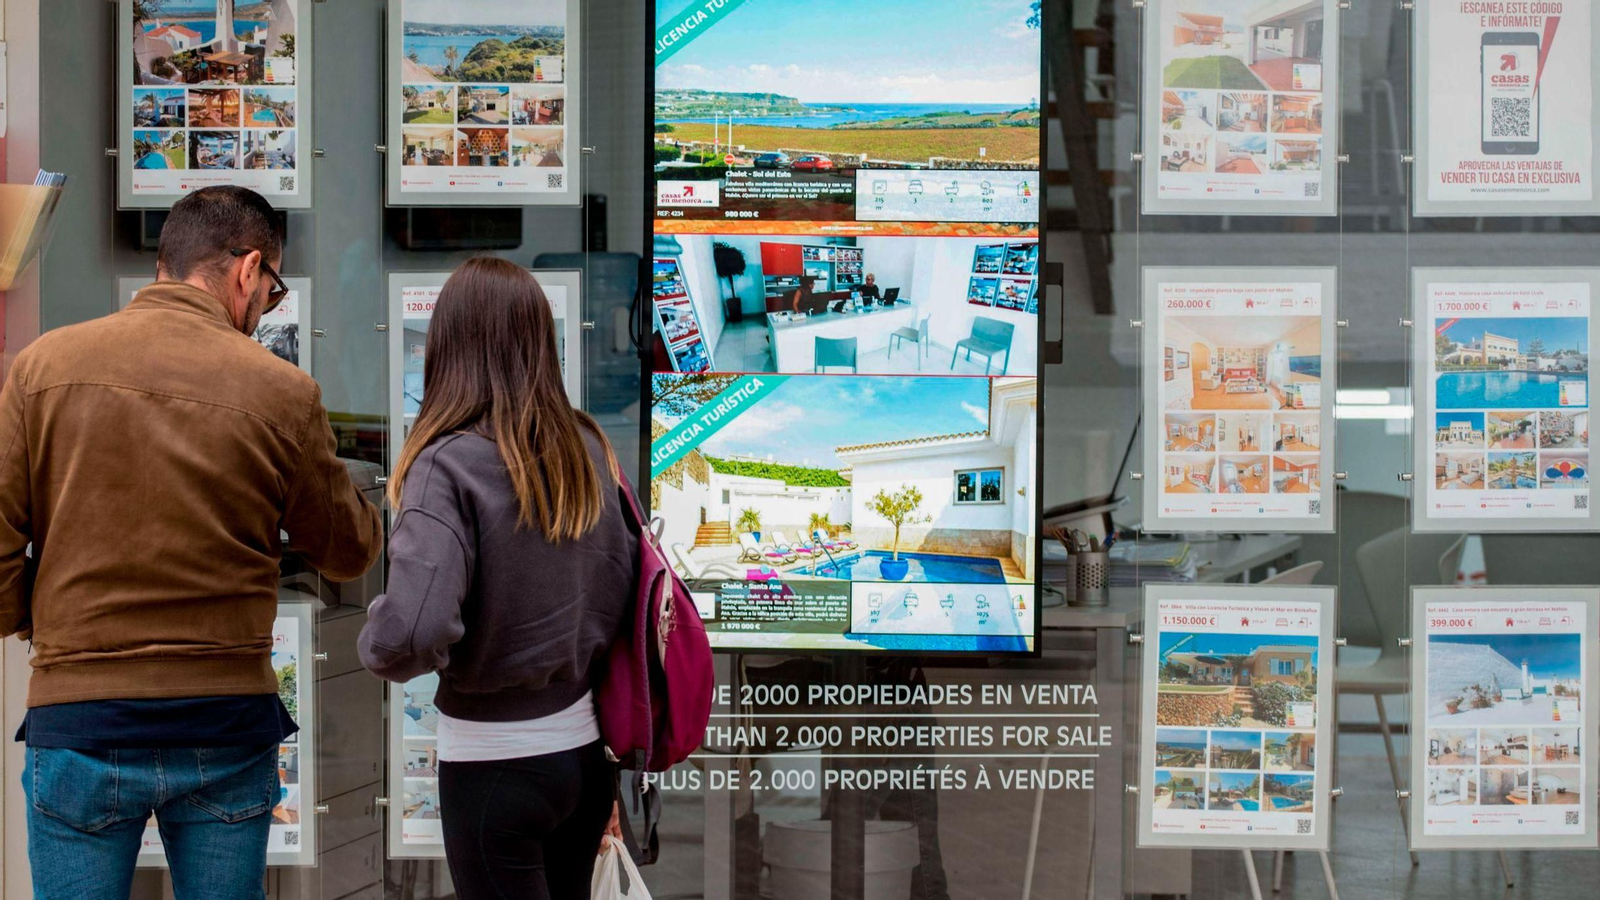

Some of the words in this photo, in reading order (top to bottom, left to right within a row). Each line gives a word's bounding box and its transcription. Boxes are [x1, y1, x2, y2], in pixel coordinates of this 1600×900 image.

[1506, 2, 1527, 13] ESTE
[1531, 0, 1562, 13] CÓDIGO
[1481, 16, 1485, 27] E
[1488, 14, 1542, 27] INFÓRMATE!
[1491, 75, 1529, 83] casas
[1459, 161, 1500, 170] APROVECHA
[1502, 161, 1515, 170] LAS
[1517, 161, 1552, 170] VENTAJAS
[1554, 161, 1563, 170] DE
[1440, 172, 1476, 183] VENDER
[1479, 172, 1490, 183] TU
[1492, 172, 1515, 183] CASA
[1518, 172, 1530, 183] EN
[1532, 172, 1581, 183] EXCLUSIVA
[701, 377, 764, 426] TURÍSTICA
[1164, 616, 1206, 625] 1.150.000
[740, 684, 800, 705] 2000
[808, 684, 973, 705] PROPIEDADES
[981, 684, 1012, 705] EN
[1021, 684, 1098, 705] VENTA
[705, 726, 766, 746] THAN
[776, 726, 842, 747] 2.000
[852, 726, 994, 746] PROPERTIES
[1002, 726, 1049, 746] FOR
[1057, 726, 1112, 746] SALE
[710, 770, 740, 790] DE
[750, 770, 816, 790] 2.000
[825, 764, 967, 790] PROPRIÉTÉS
[974, 764, 991, 789] À
[999, 769, 1094, 789] VENDRE
